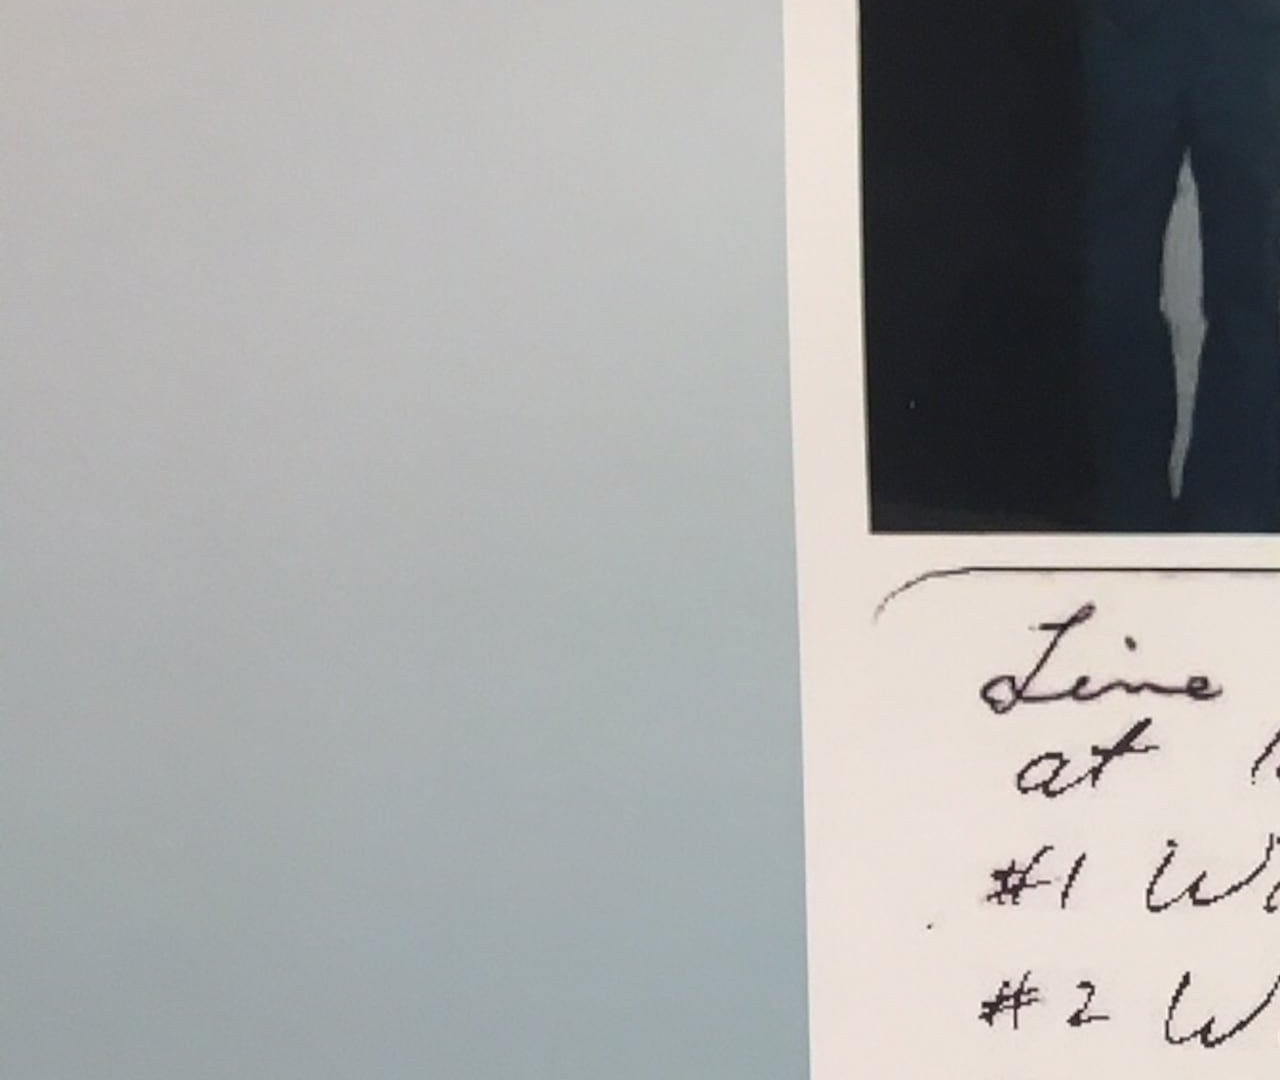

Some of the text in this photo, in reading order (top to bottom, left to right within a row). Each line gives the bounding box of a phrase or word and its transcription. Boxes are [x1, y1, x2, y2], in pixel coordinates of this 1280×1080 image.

[978, 601, 1224, 716] Line
[1015, 717, 1161, 800] at
[985, 844, 1087, 910] #1
[977, 969, 1111, 1031] #2
